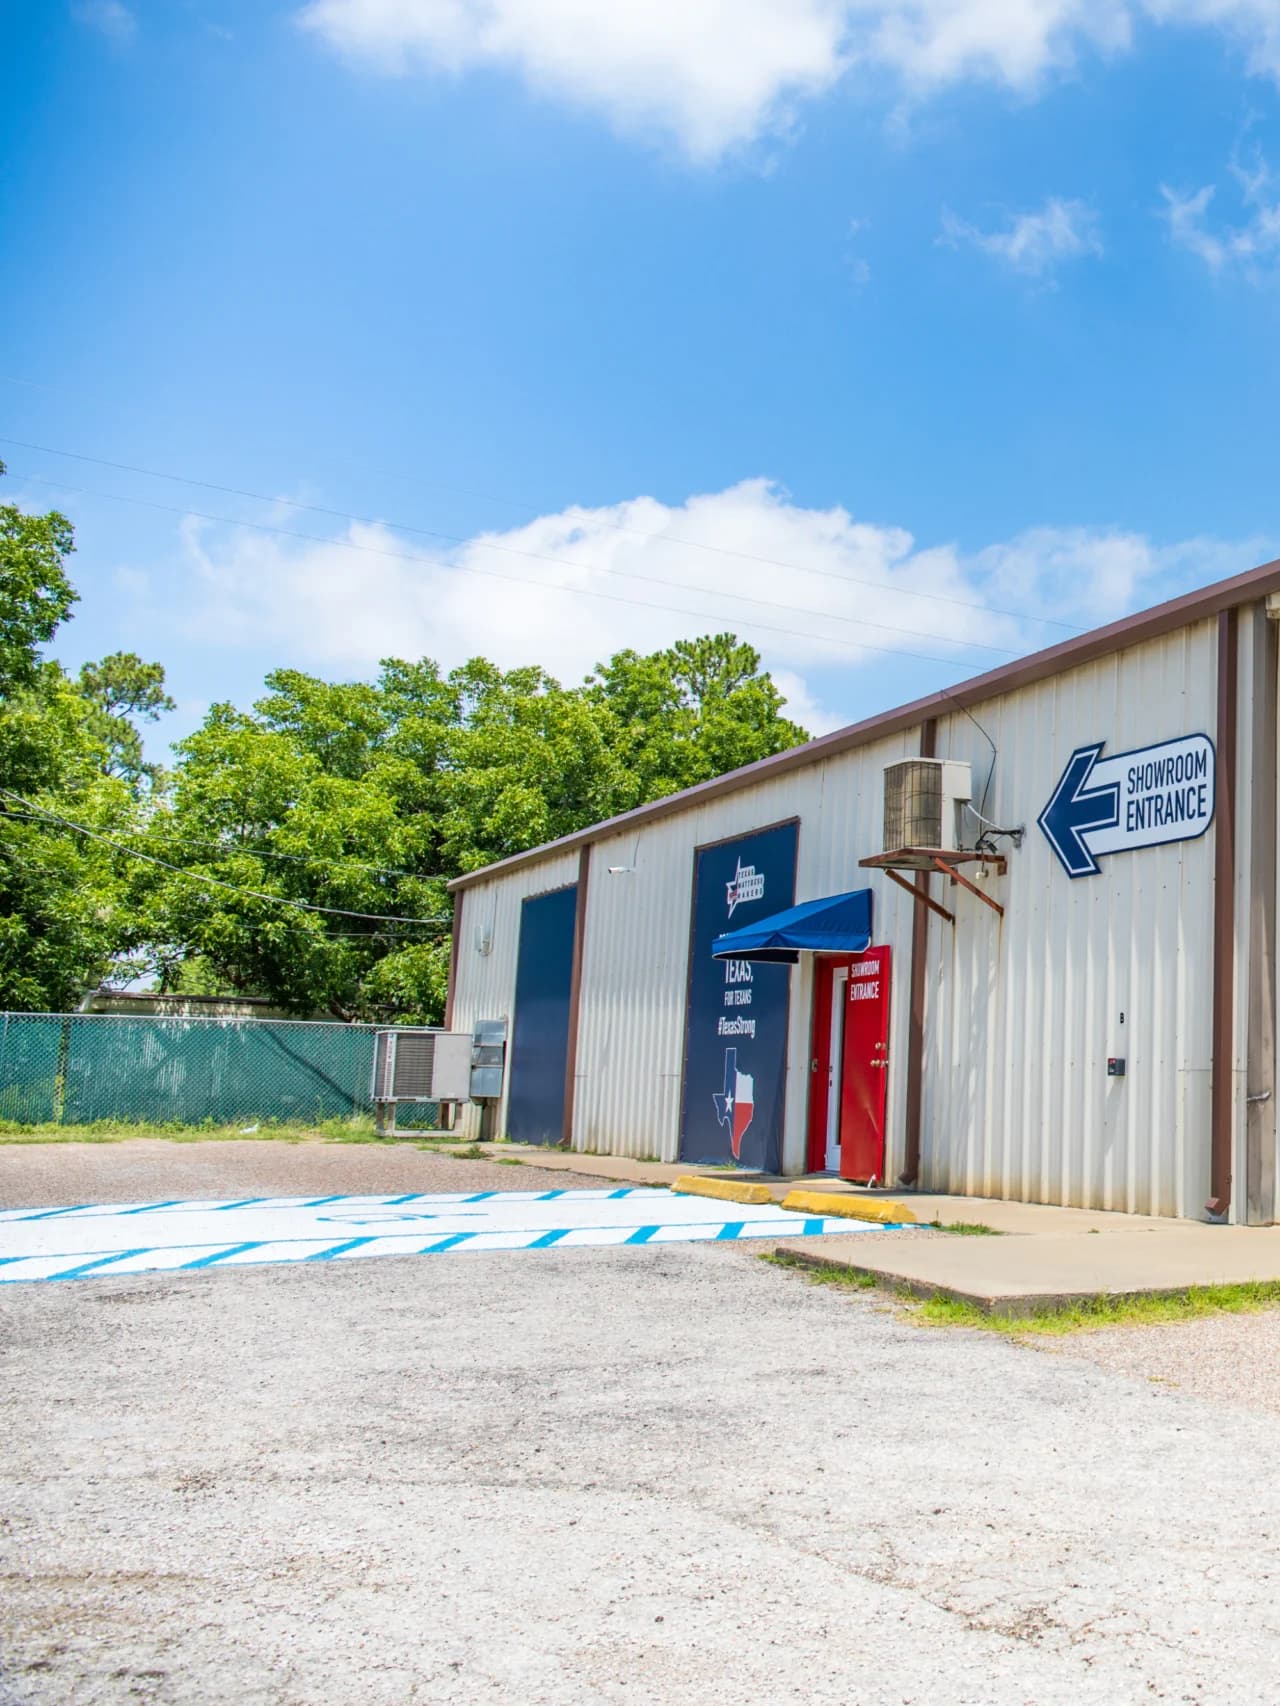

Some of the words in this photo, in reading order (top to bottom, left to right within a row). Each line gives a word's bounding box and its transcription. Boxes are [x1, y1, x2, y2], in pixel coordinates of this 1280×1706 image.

[1127, 749, 1207, 795] SHOWROOM
[1126, 784, 1207, 832] ENTRANCE
[851, 960, 880, 978] SHOWROOM
[724, 990, 734, 1006] FOR
[734, 989, 752, 1005] TEXANS
[850, 981, 880, 1001] ENTRANCE
[718, 1016, 756, 1039] #TexasStrong
